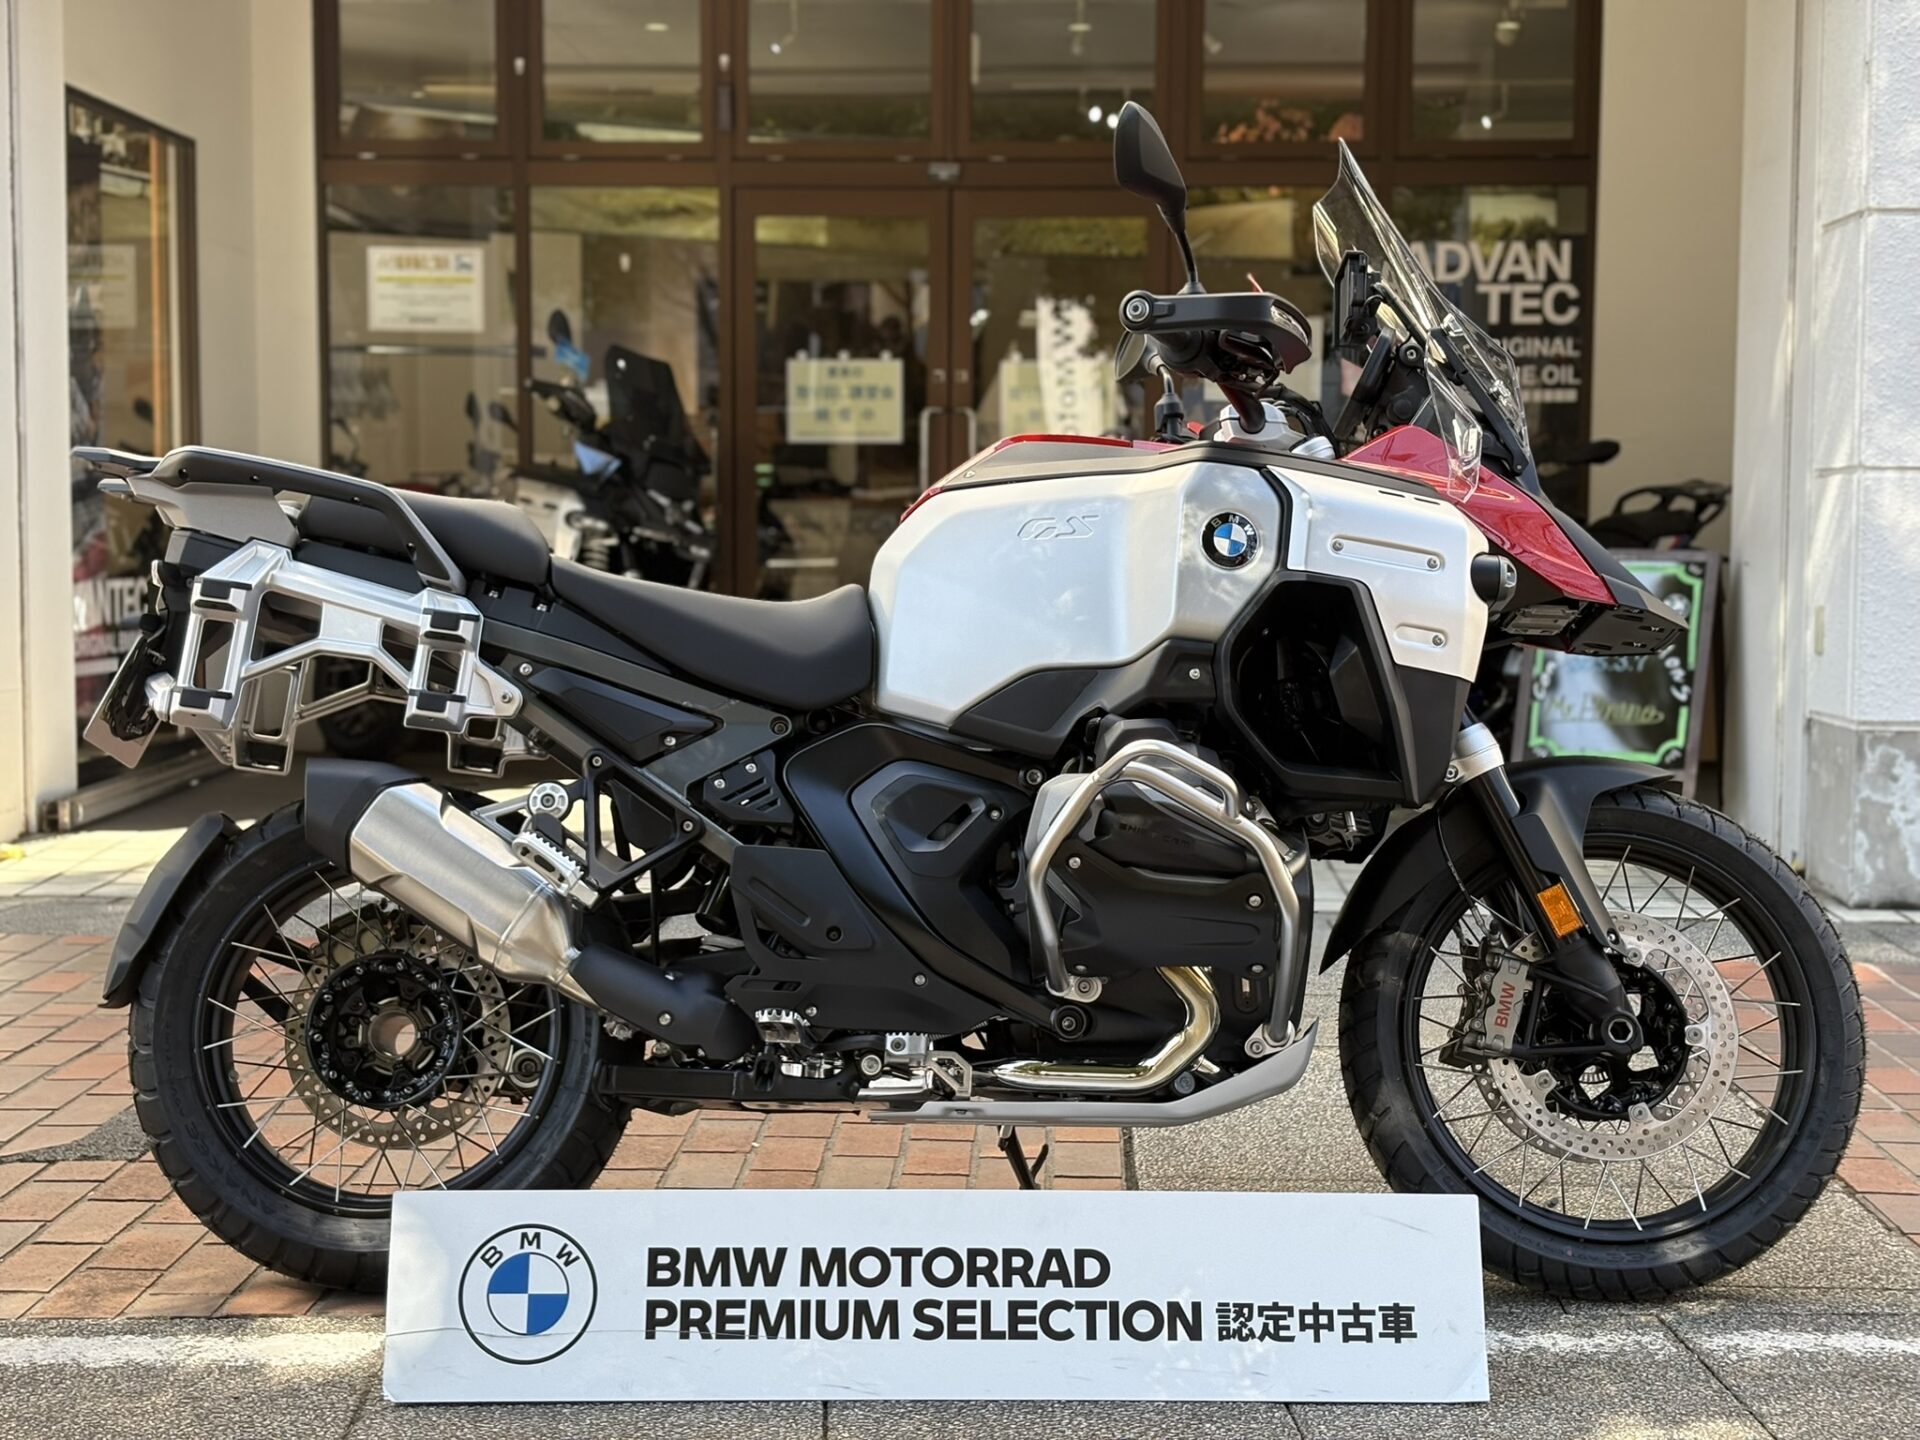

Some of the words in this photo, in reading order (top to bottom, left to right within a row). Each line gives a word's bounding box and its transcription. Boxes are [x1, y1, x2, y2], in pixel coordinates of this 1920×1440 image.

[1408, 239, 1573, 283] ADVAN
[1476, 283, 1581, 326] TEC
[1541, 363, 1583, 386] OIL
[1017, 514, 1101, 541] GS
[1494, 982, 1515, 1027] BMW
[480, 1231, 581, 1269] BMW
[647, 1247, 787, 1287] BMW
[799, 1247, 1110, 1288] MOTORRAD
[646, 1299, 899, 1340] PREMIUM
[912, 1299, 1202, 1342] SELECTION
[1216, 1302, 1418, 1343] 認定中古車
